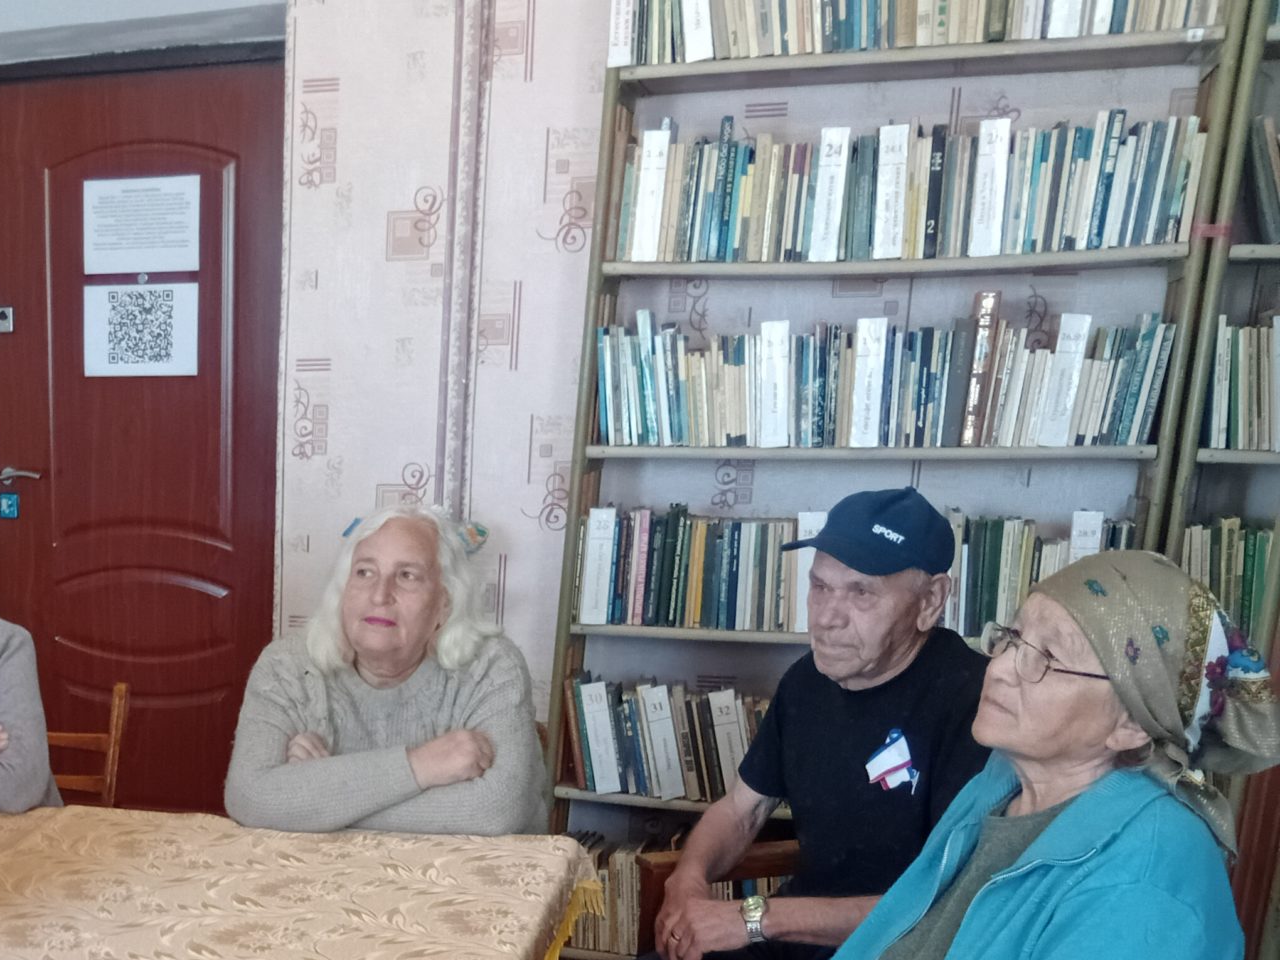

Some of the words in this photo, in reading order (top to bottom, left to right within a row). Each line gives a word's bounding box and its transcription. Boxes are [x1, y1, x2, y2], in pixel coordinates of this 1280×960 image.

[926, 219, 935, 234] 2
[872, 523, 906, 545] SPORT
[588, 693, 603, 705] 30
[650, 703, 664, 713] 31
[717, 706, 731, 717] 32
